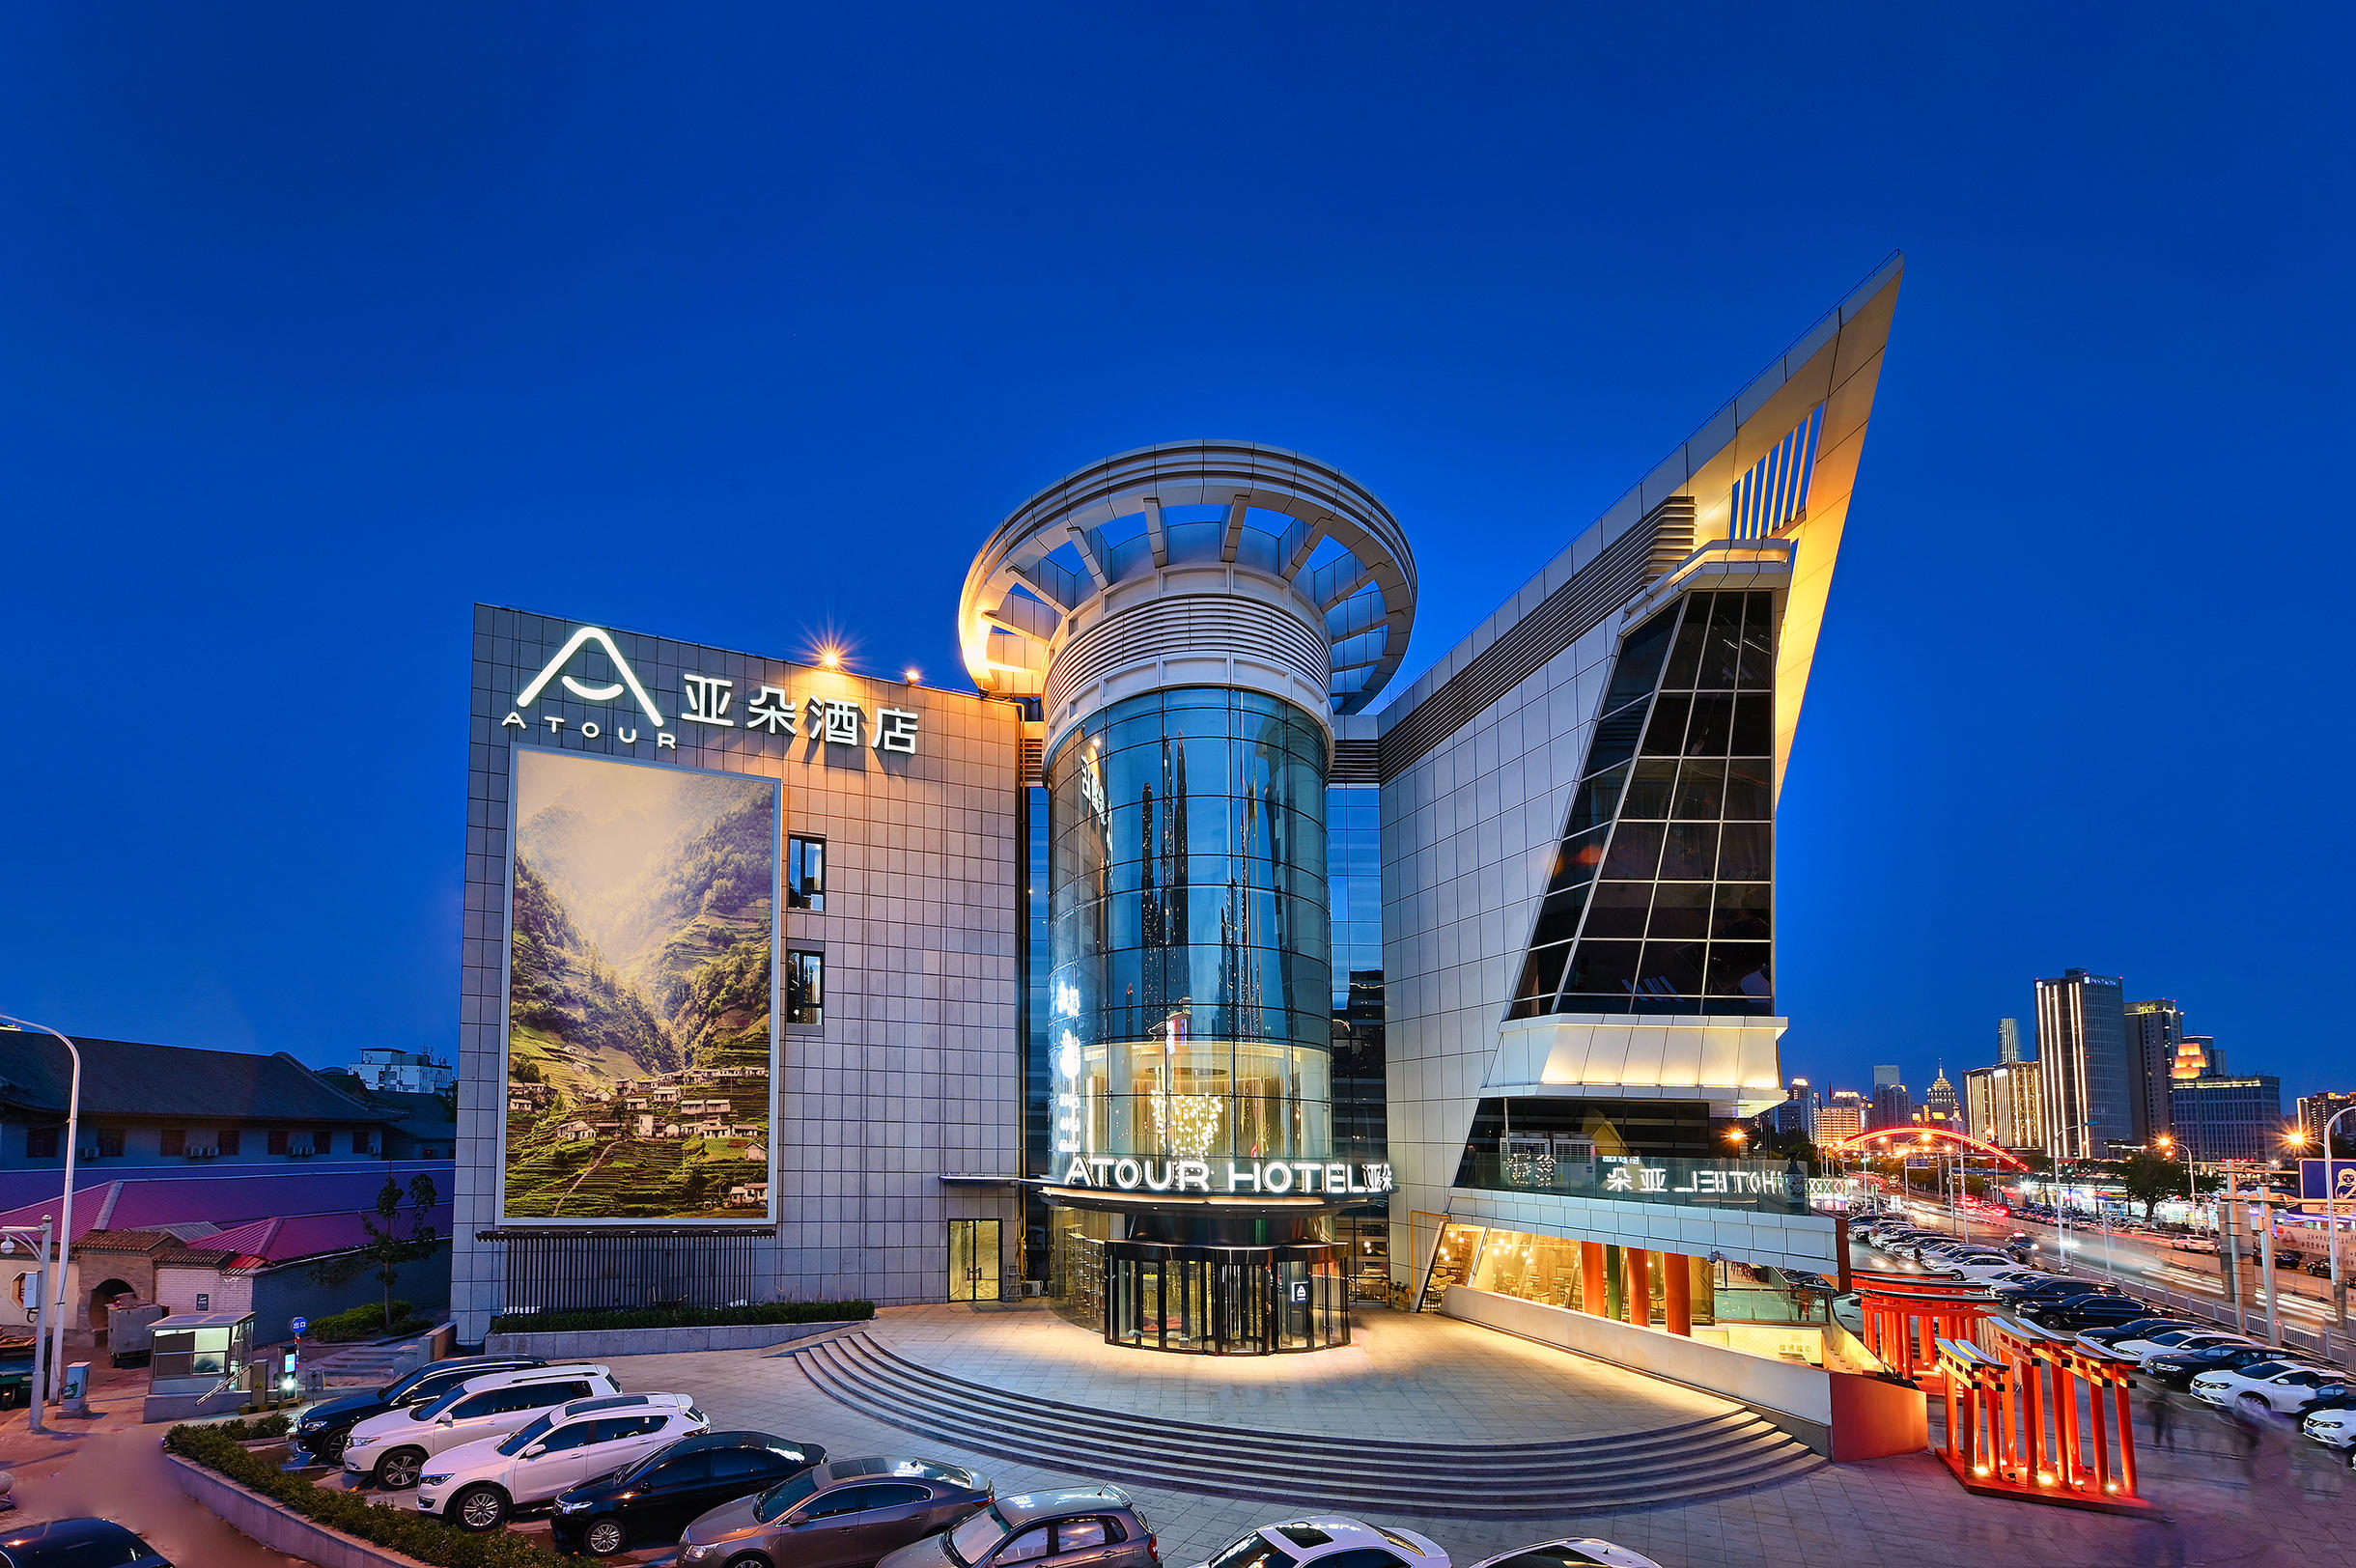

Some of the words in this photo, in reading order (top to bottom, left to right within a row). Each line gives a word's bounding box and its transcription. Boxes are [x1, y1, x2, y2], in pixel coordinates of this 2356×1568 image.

[501, 712, 676, 749] ATOUR
[681, 673, 919, 755] 亚朵酒店
[1064, 1157, 1209, 1192] ATOUR
[1228, 1162, 1366, 1193] HOTEL
[1363, 1163, 1393, 1193] 亚朵
